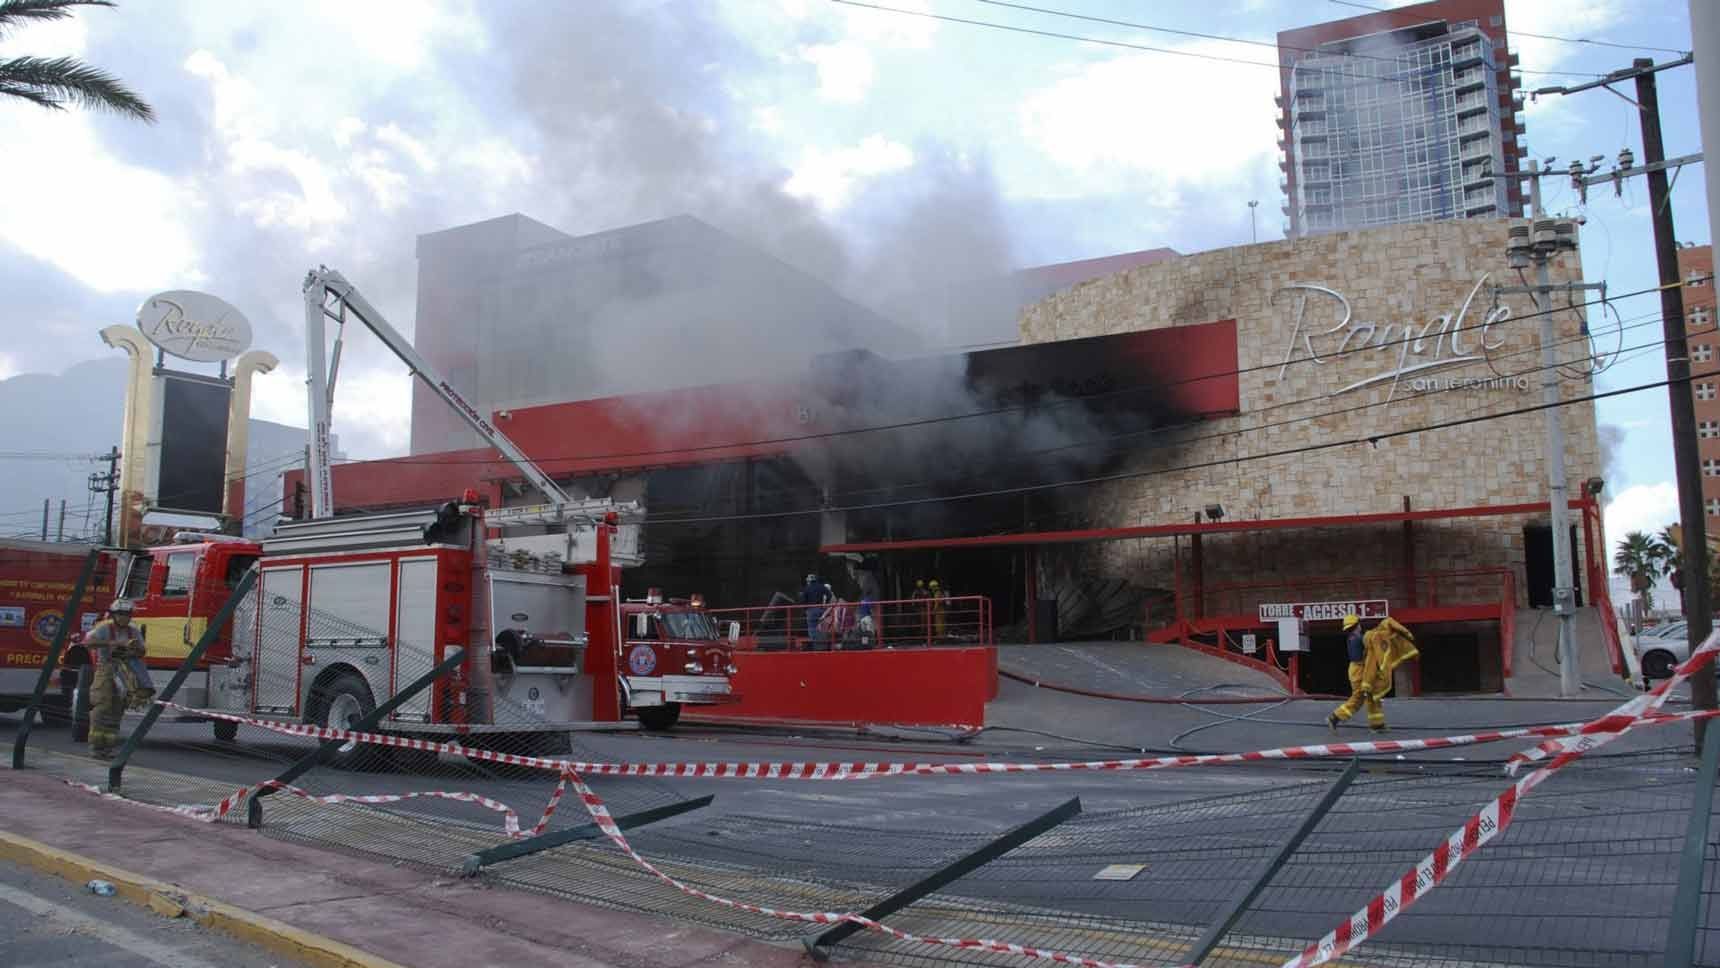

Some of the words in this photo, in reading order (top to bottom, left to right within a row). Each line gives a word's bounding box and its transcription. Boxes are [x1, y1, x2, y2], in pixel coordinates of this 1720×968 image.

[1271, 272, 1511, 408] Royale
[1262, 604, 1294, 617] TORRE
[1303, 602, 1356, 620] ACCESO
